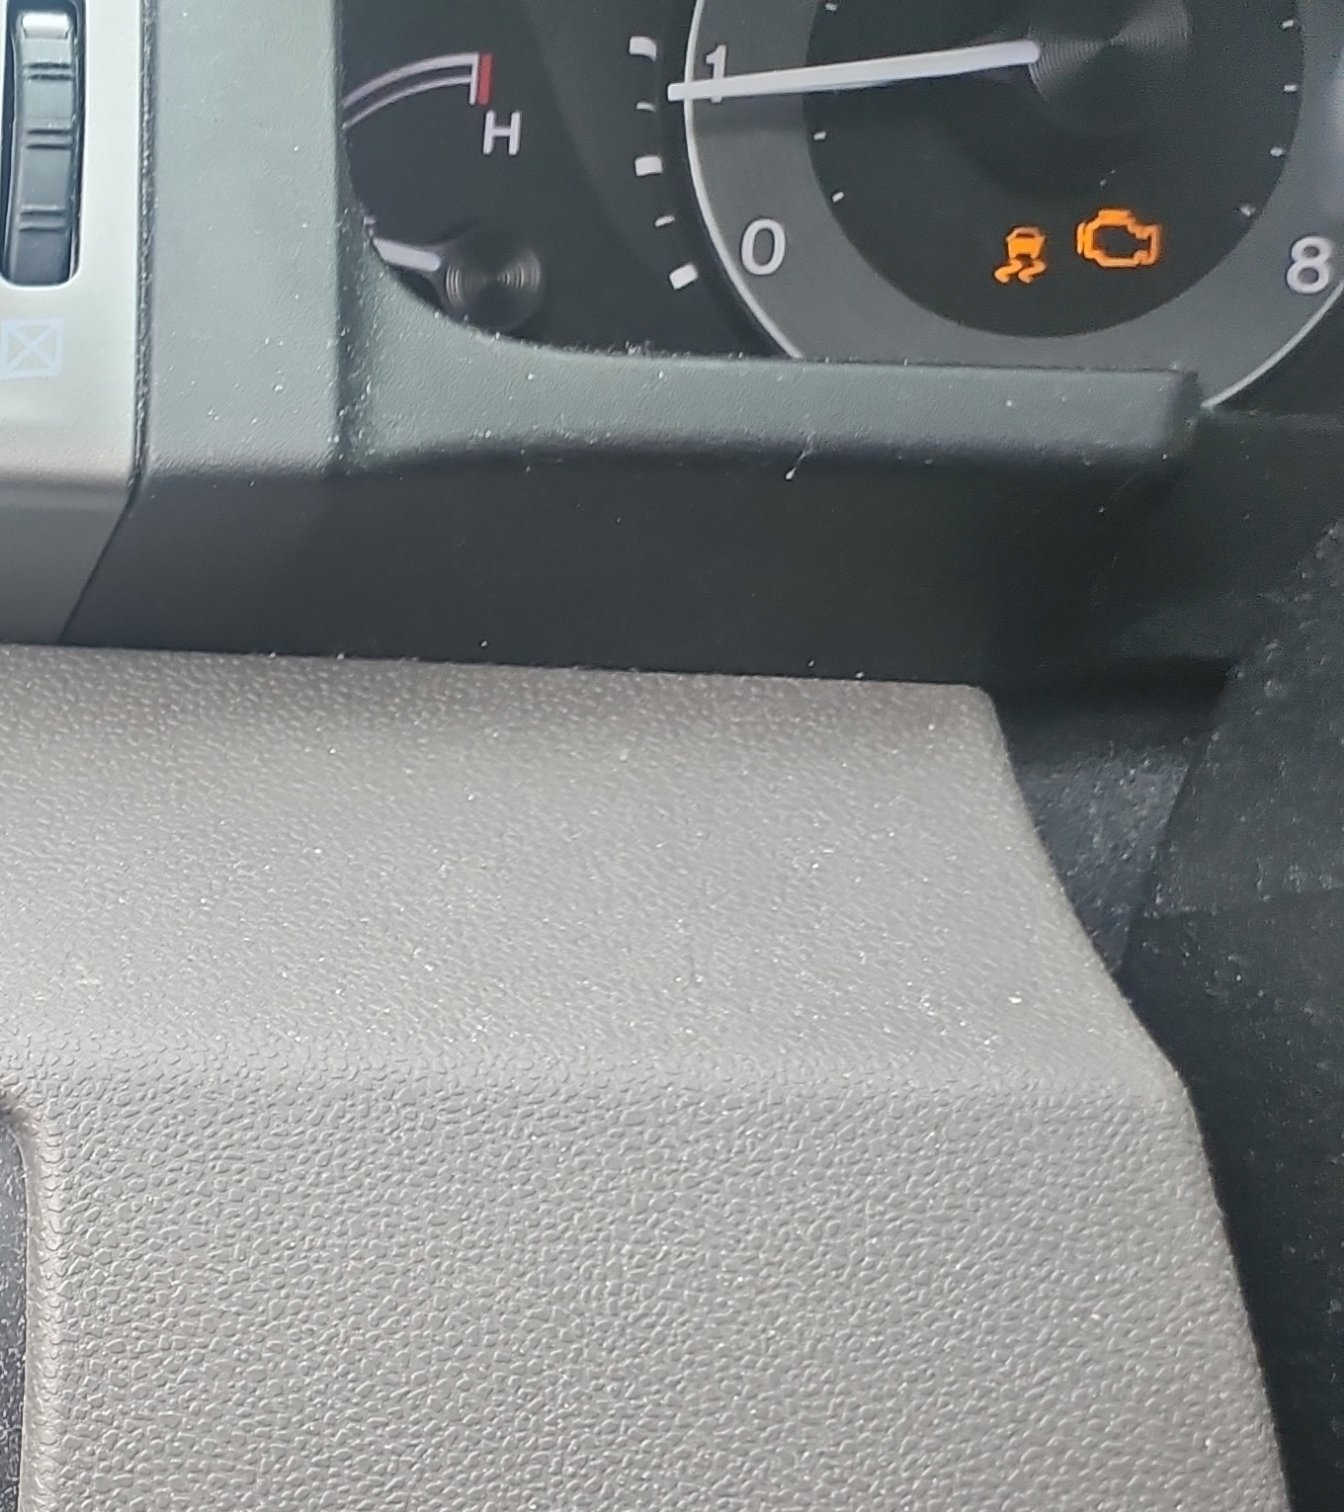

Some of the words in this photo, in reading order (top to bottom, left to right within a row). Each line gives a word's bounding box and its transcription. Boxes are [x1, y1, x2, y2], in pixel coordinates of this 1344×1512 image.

[483, 110, 521, 155] H
[741, 218, 786, 275] 0
[1286, 235, 1331, 294] 8
